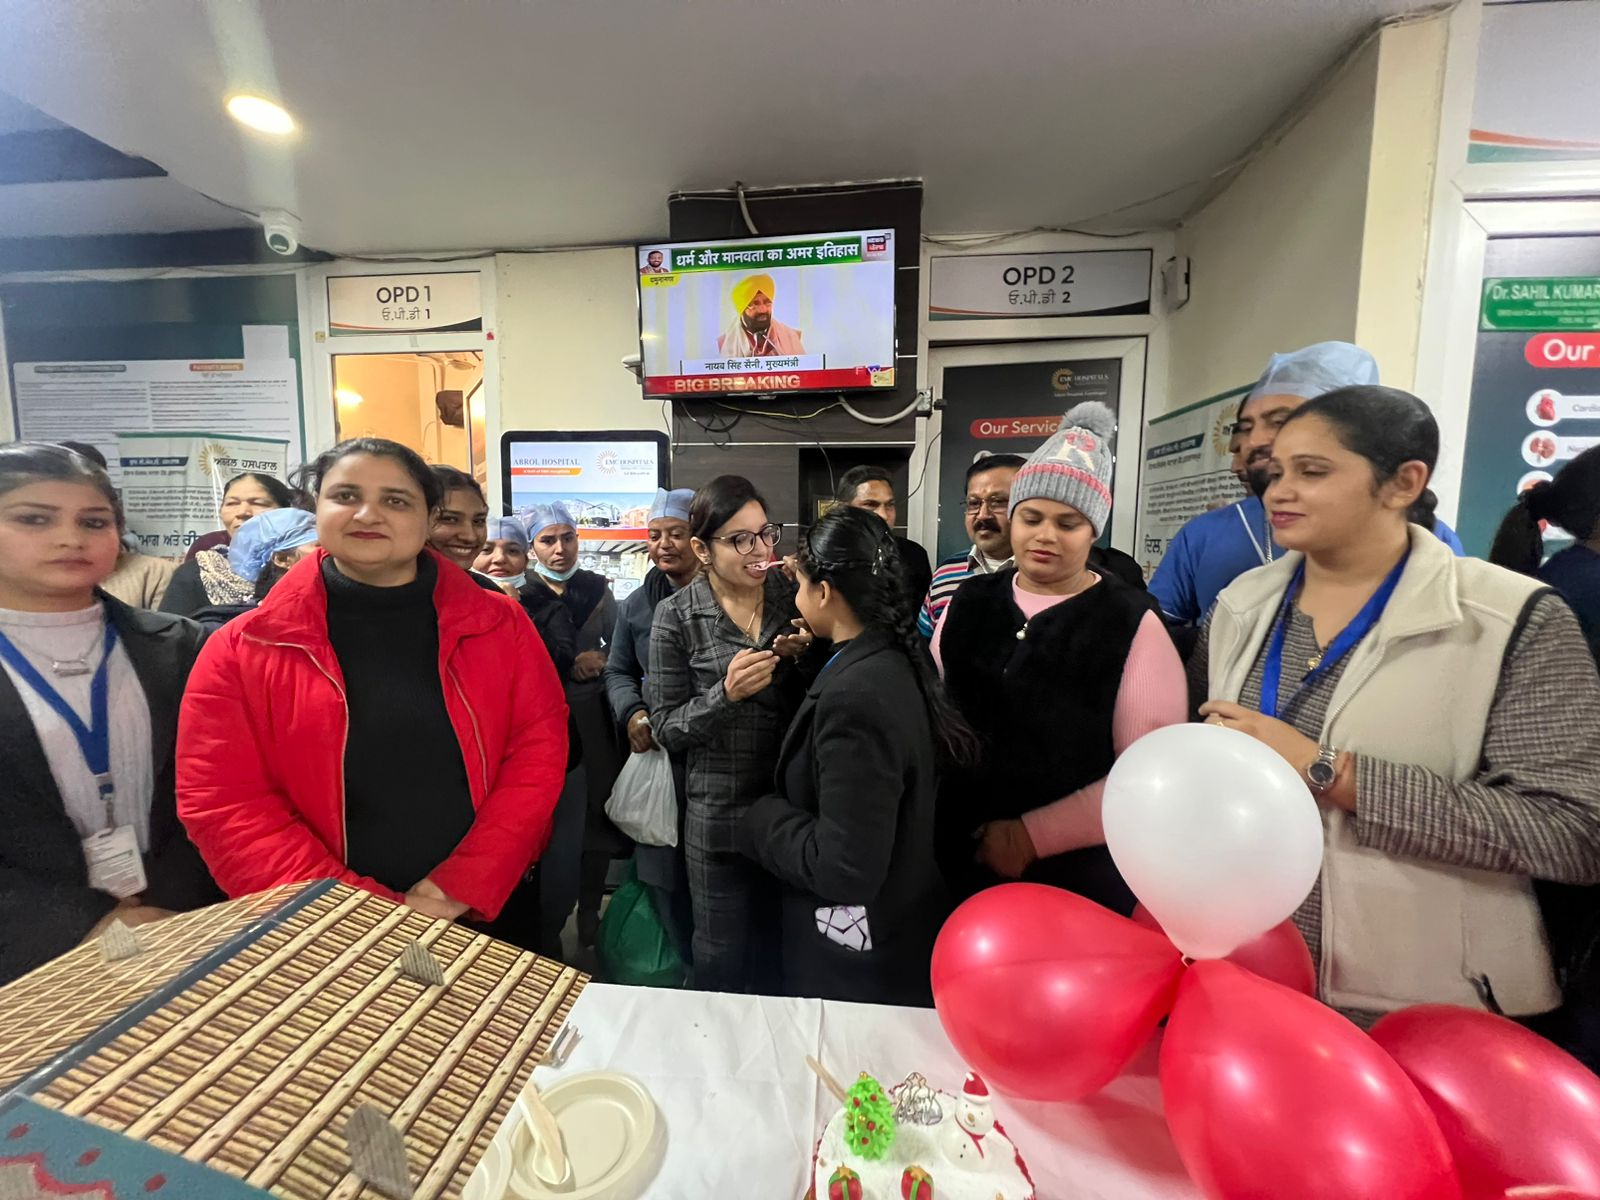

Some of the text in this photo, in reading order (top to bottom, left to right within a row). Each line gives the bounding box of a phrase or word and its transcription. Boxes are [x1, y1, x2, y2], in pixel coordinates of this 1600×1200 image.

[676, 253, 695, 267] धर्म
[698, 249, 719, 266] और
[722, 249, 764, 263] मानवता
[767, 247, 783, 261] का
[786, 245, 814, 261] अमर
[816, 241, 859, 260] इतिहास
[1003, 264, 1075, 286] OPD 2
[376, 285, 431, 304] OPD 1
[1008, 288, 1071, 305] ਓ.ਪੀ.ਡੀ 2
[1492, 285, 1509, 300] Dr.
[1510, 284, 1550, 300] SAHIL
[382, 306, 431, 321] ਓ.ਪੀ.ਡੀ 1
[1543, 338, 1595, 362] Our
[705, 356, 799, 371] नायब सिंह सैनी, मुख्यमंत्री
[674, 375, 800, 393] BIG BREAKING
[980, 420, 1062, 435] Our Servic
[241, 459, 278, 471] ਹਸਪਤਾਲ
[513, 458, 580, 466] ABROL HOSPITAL
[163, 530, 181, 547] ਅਤੇ
